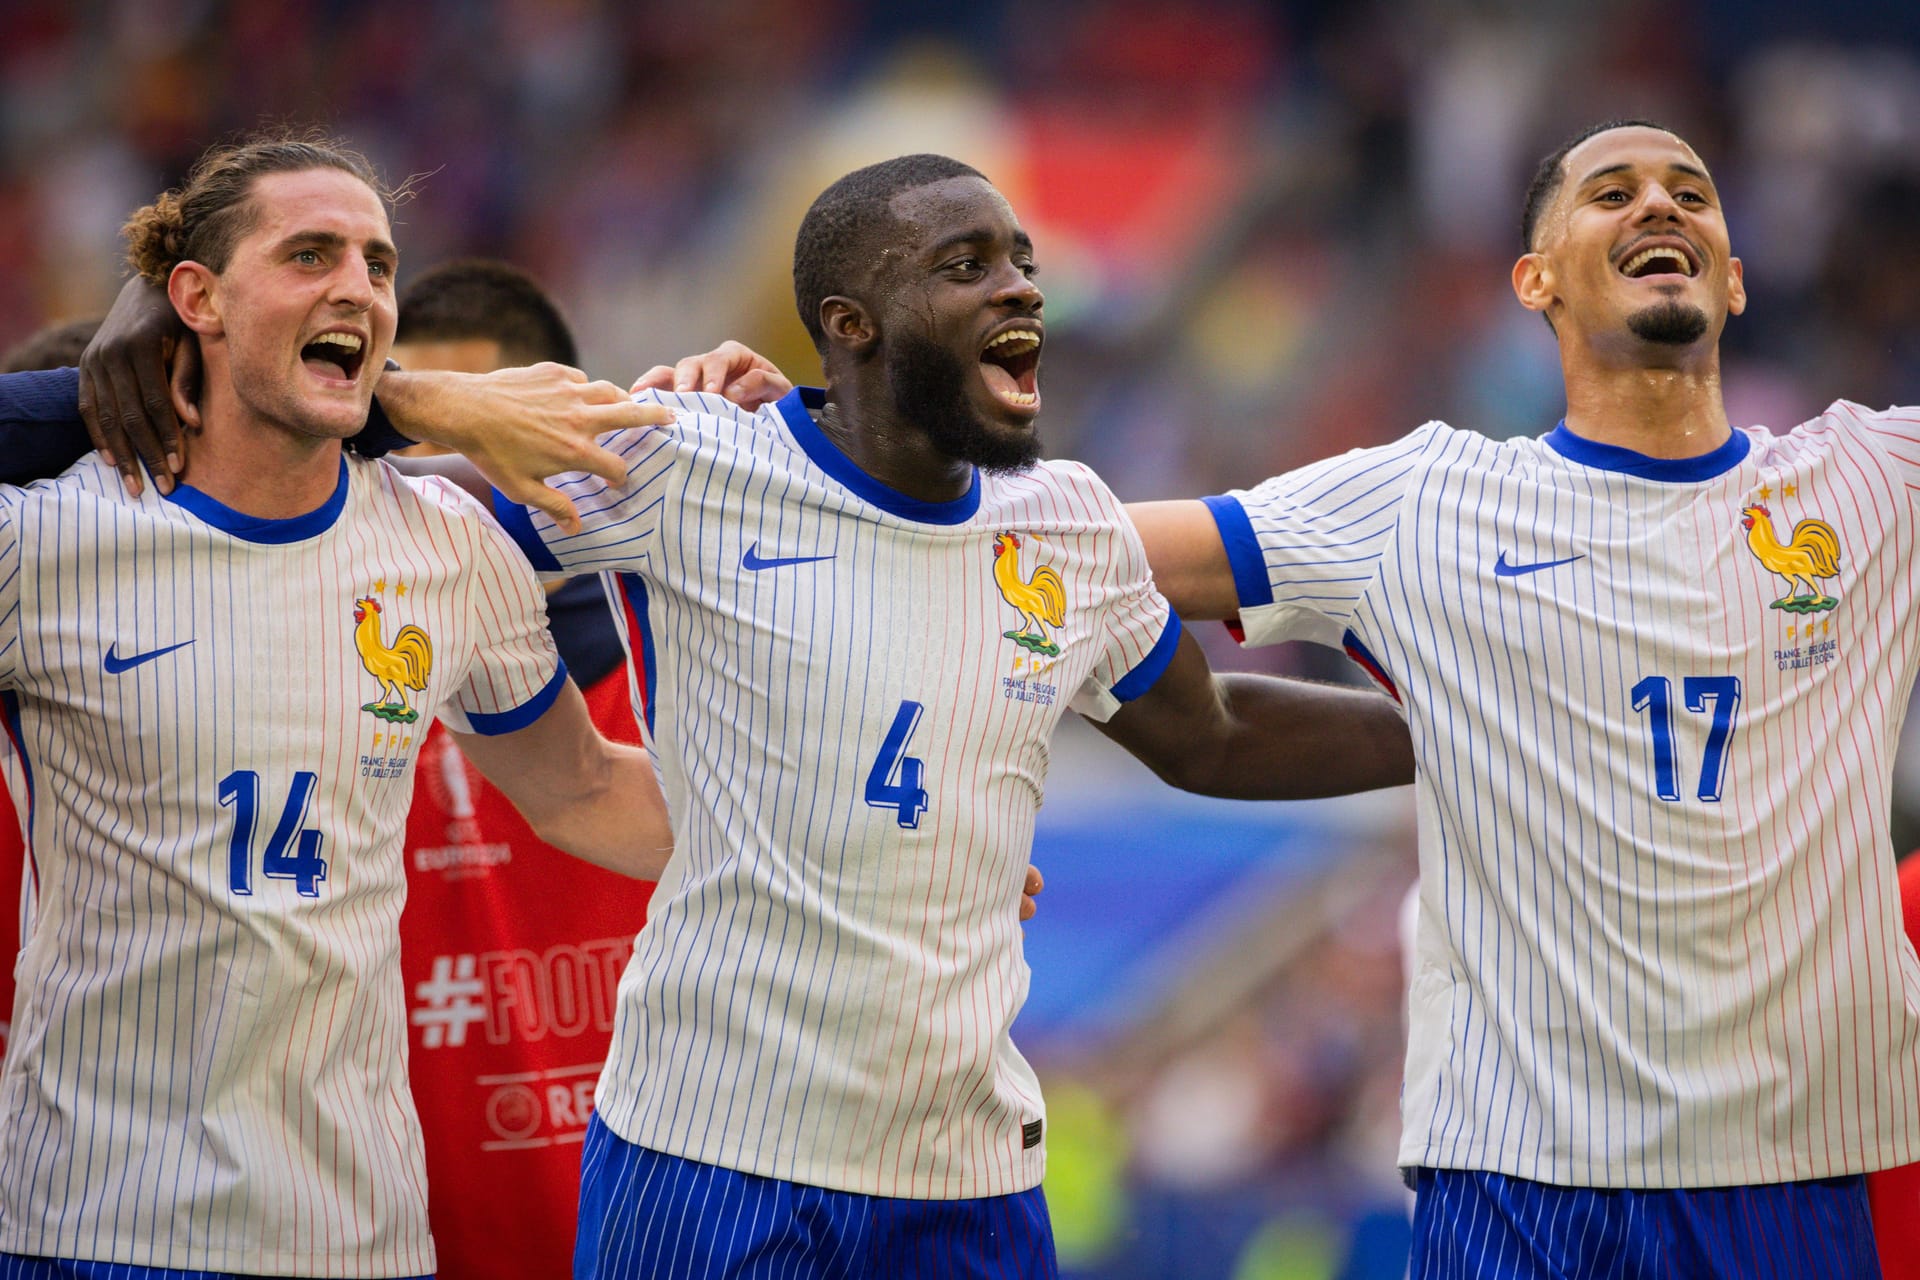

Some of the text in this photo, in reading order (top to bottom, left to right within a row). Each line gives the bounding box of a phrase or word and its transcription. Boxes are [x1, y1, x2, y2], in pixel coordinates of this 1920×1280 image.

[1774, 648, 1801, 660] FRANCE
[1808, 640, 1836, 655] BELGIQUE
[1778, 652, 1834, 671] 01 JUILLET 2024
[1003, 677, 1026, 691] FRANCE
[1004, 688, 1014, 699] 01
[1015, 690, 1036, 702] JUILLET
[1631, 676, 1742, 802] 17
[361, 755, 384, 767] FRANCE
[865, 699, 929, 829] 4
[218, 770, 327, 897] 14
[410, 935, 634, 1049] #FOOT
